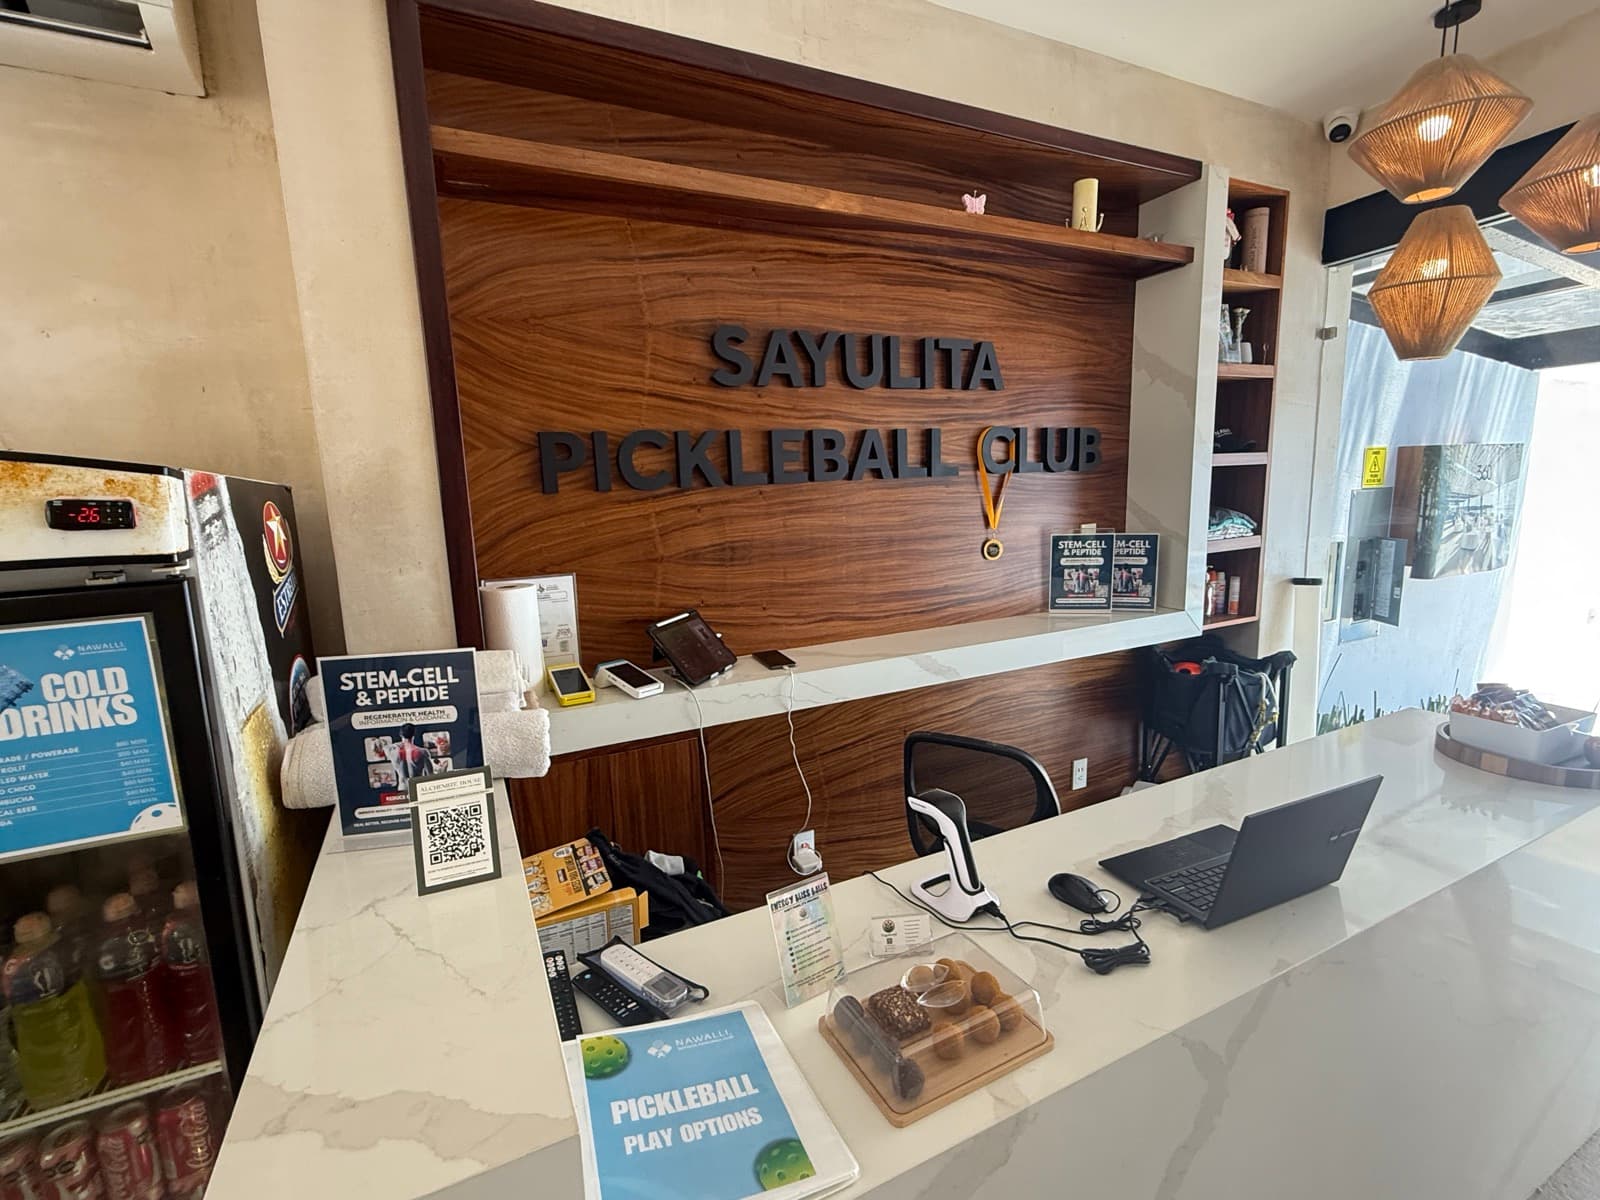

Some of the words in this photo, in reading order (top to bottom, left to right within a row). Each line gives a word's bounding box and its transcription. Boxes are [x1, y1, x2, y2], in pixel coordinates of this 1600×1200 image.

[710, 324, 1004, 391] SAYULITA
[537, 428, 959, 495] PICKLEBALL
[982, 425, 1102, 473] CLUB
[1058, 540, 1107, 549] STEM-CELL
[1071, 548, 1102, 556] PEPTIDE
[41, 667, 128, 702] COLD
[340, 666, 459, 691] STEM-CELL
[356, 691, 373, 706] &
[375, 685, 449, 705] PEPTIDE
[0, 694, 138, 739] DRINKS
[364, 710, 416, 721] REGENERATIVE
[418, 709, 446, 717] HEALTH
[18, 772, 49, 782] WATER
[609, 1073, 759, 1124] PICKLEBALL
[623, 1127, 673, 1155] PLAY
[680, 1107, 763, 1143] OPTIONS
